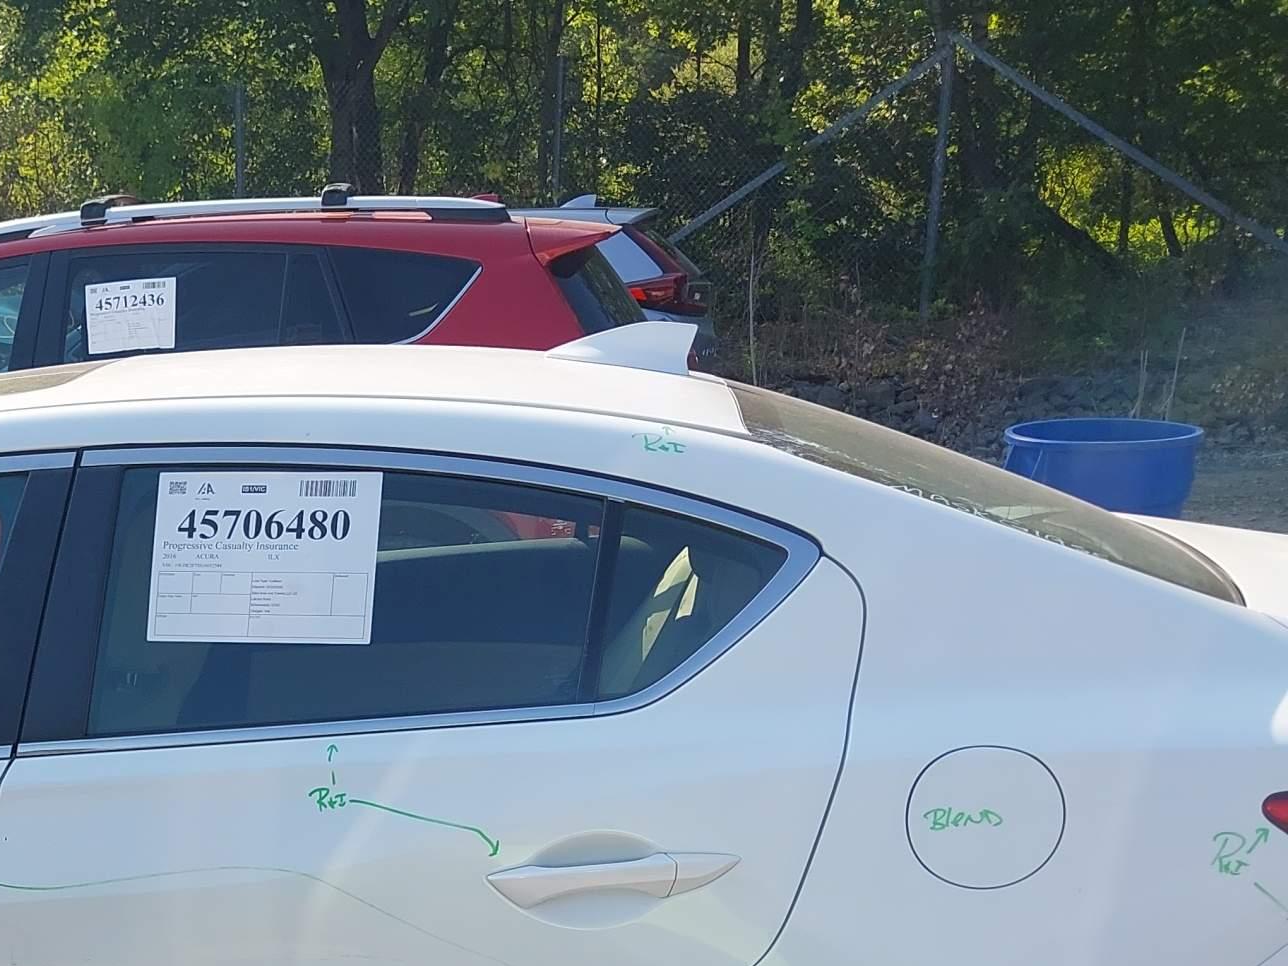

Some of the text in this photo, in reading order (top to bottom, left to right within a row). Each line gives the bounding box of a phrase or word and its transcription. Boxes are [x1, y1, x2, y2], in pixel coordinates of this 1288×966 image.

[95, 292, 165, 311] 45712436
[177, 509, 351, 541] 45706480
[162, 541, 300, 552] Progressive Casualty Insurance
